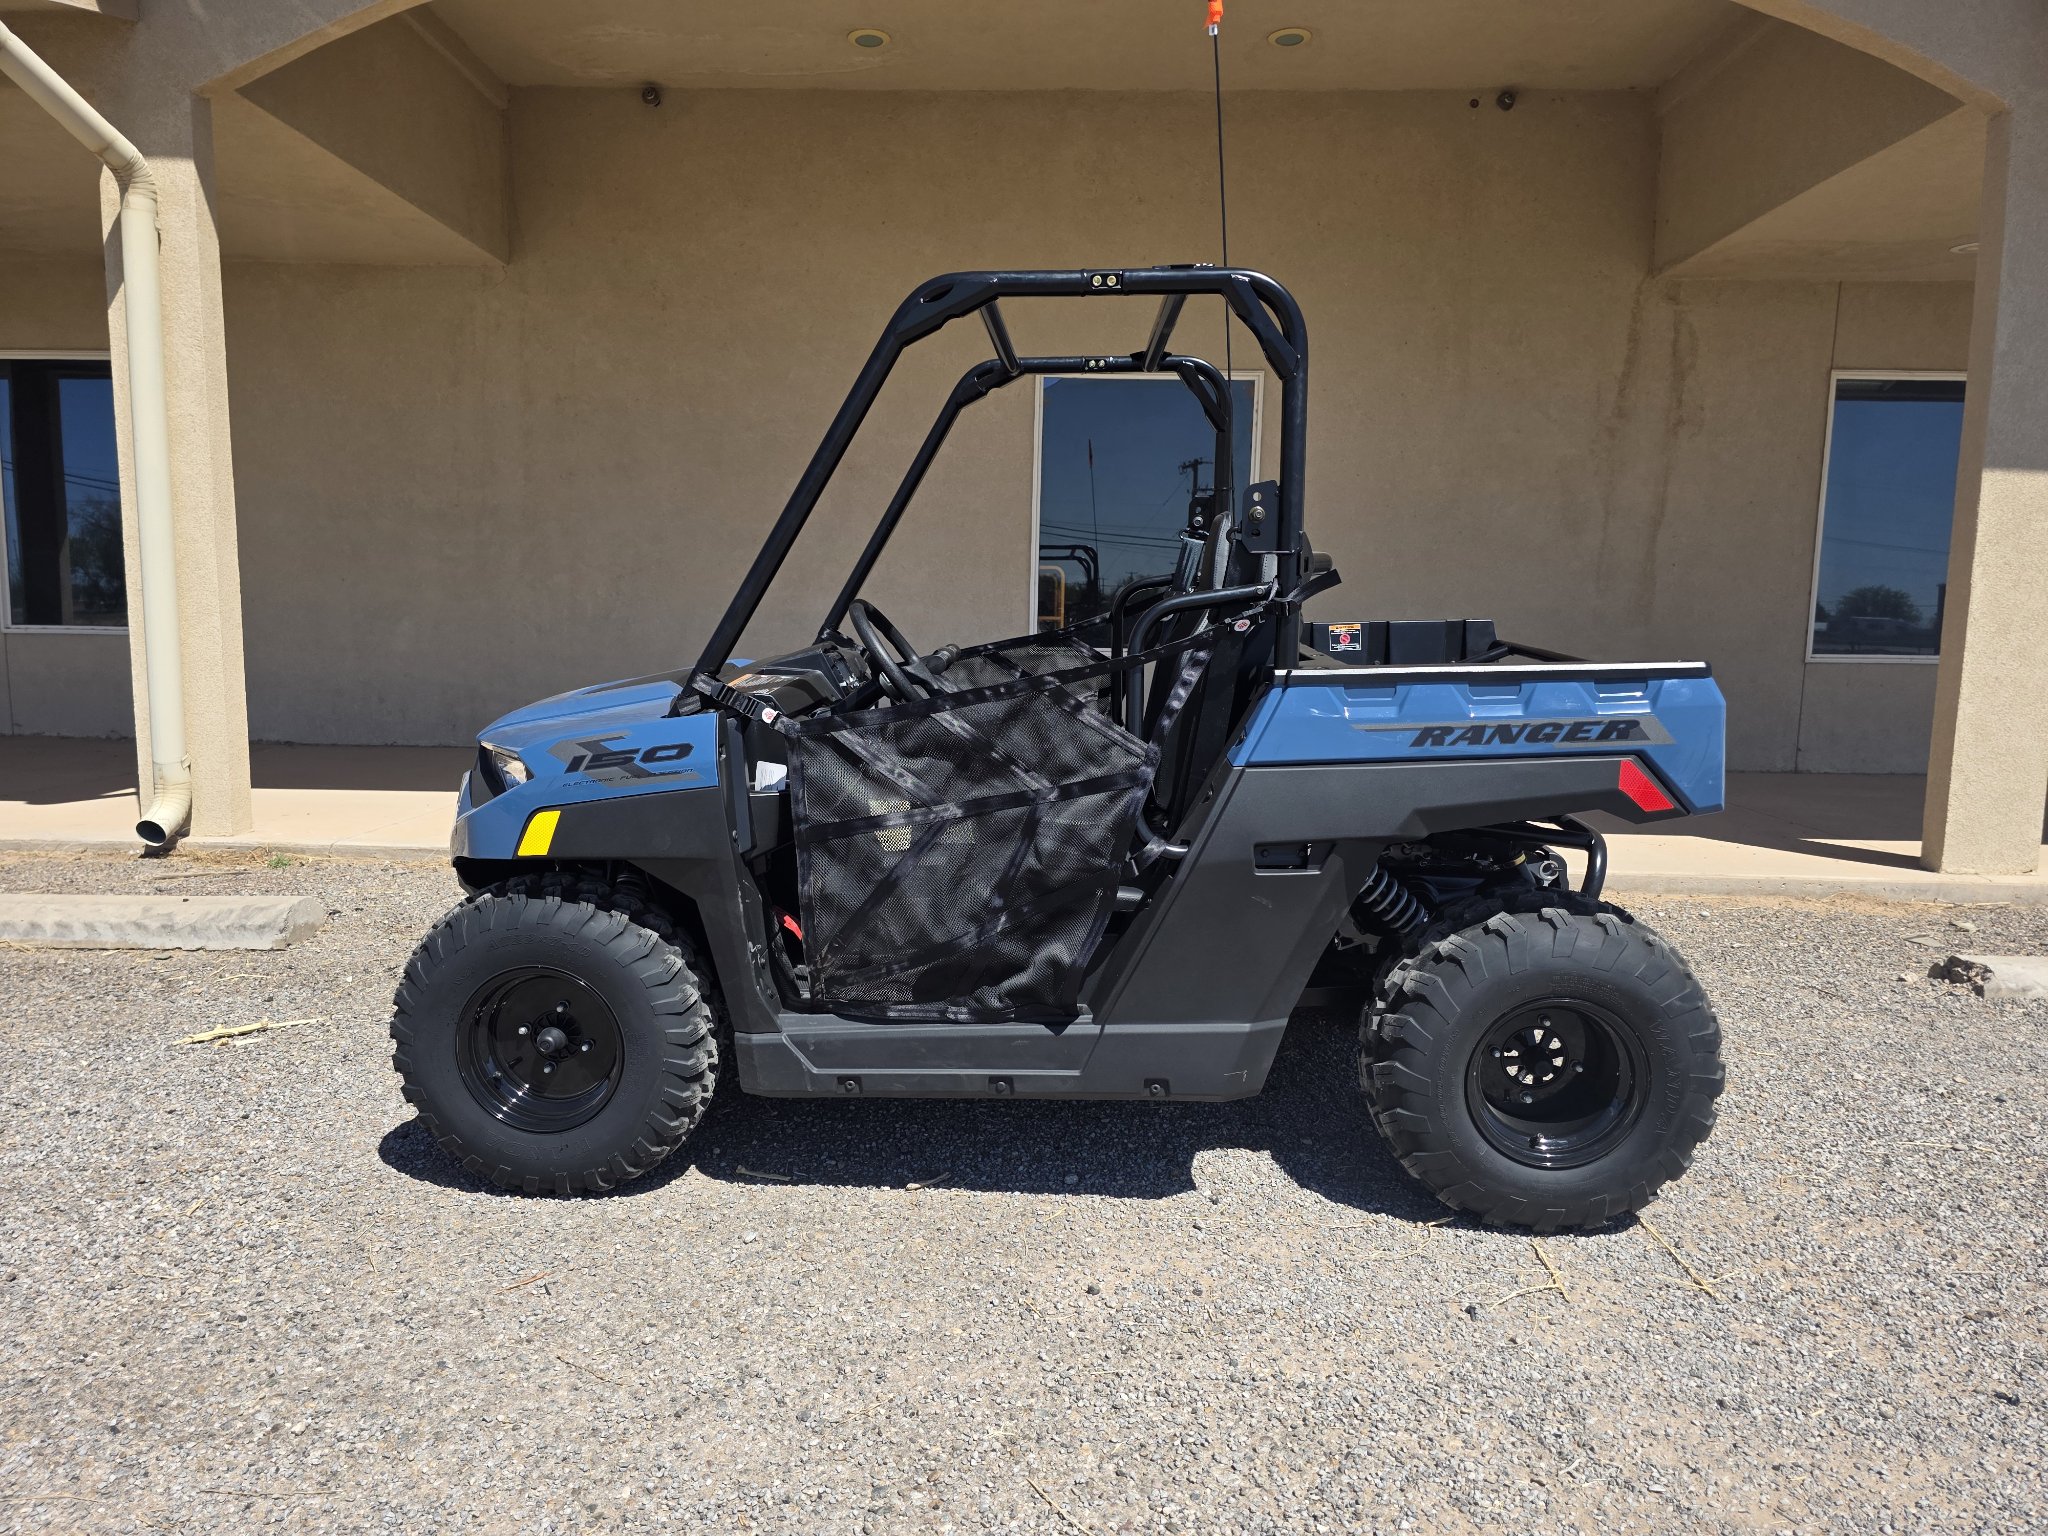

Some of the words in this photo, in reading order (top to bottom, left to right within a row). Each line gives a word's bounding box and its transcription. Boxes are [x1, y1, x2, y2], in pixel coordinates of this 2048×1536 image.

[1408, 719, 1642, 748] RANGER
[563, 742, 695, 775] 150
[561, 777, 615, 788] ELECTRONIC
